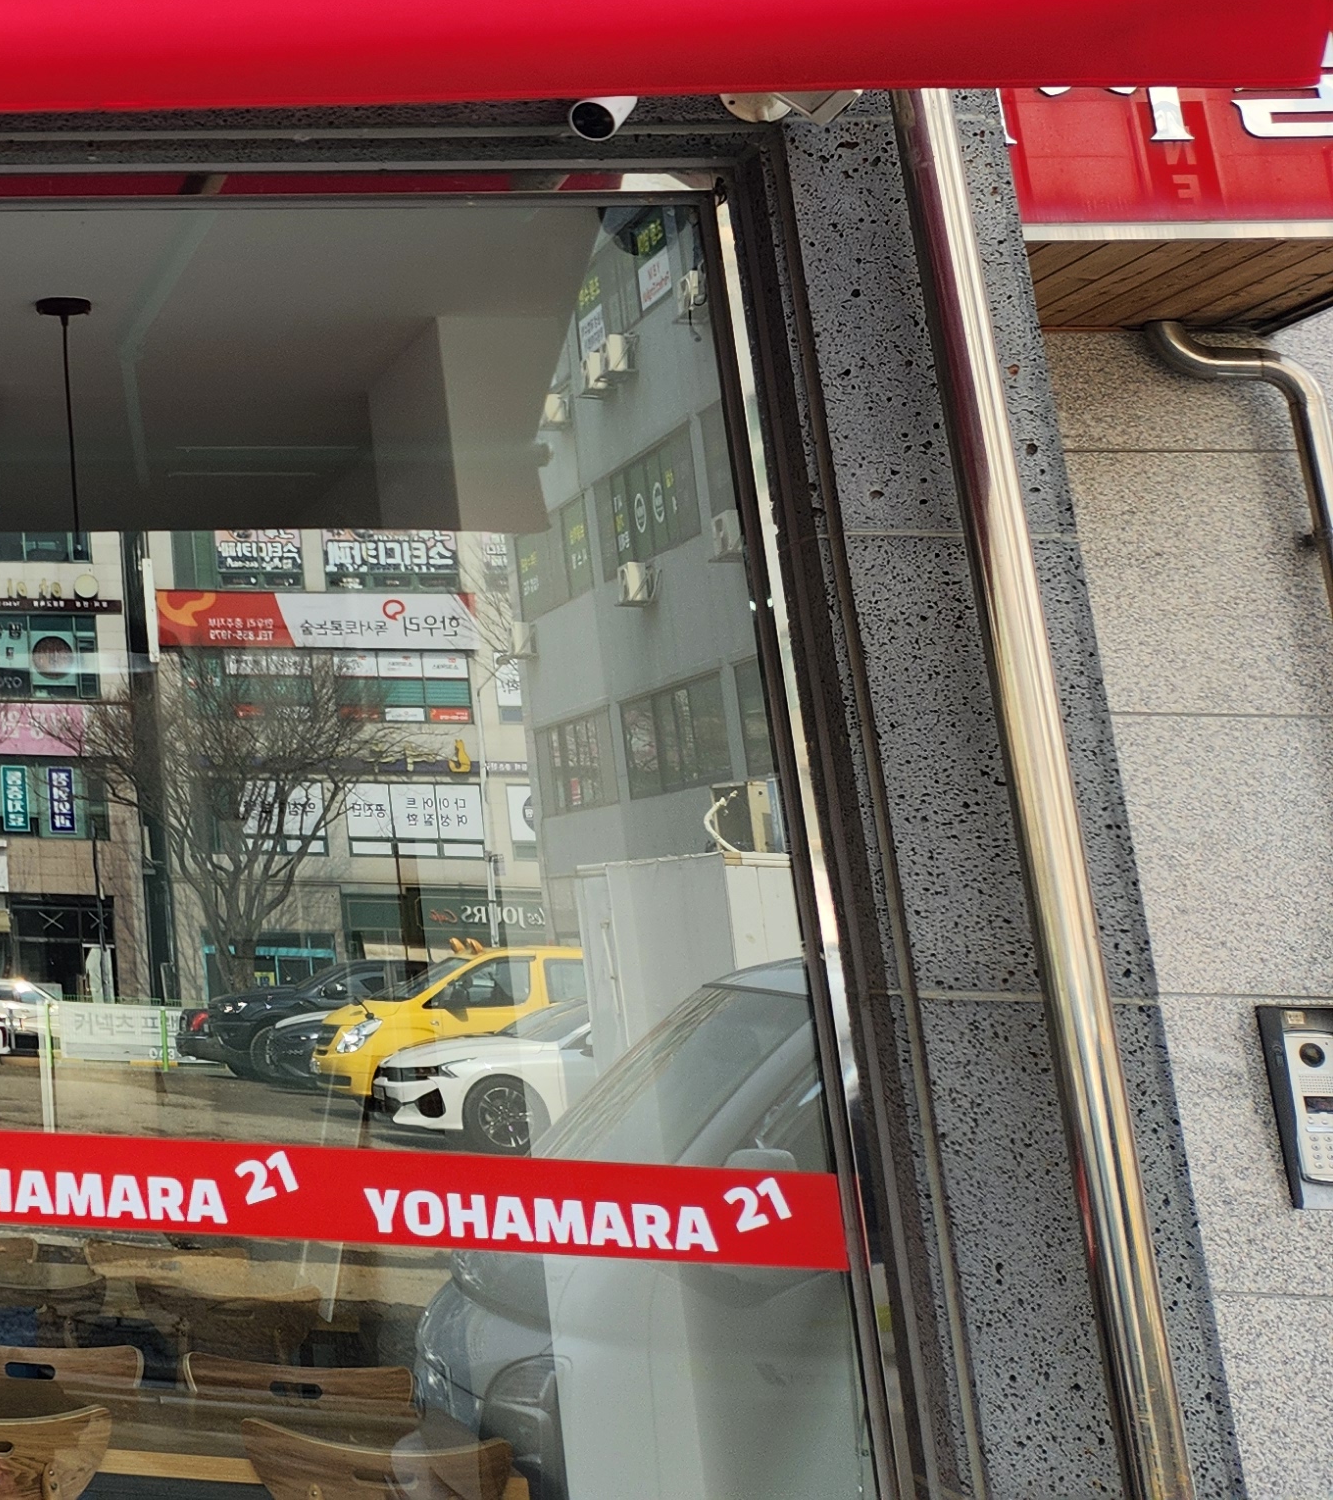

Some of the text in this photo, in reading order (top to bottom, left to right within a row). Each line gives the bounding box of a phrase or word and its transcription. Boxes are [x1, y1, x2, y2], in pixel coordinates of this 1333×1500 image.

[234, 1150, 300, 1206] 21
[363, 1176, 793, 1254] YOHAMARA 21
